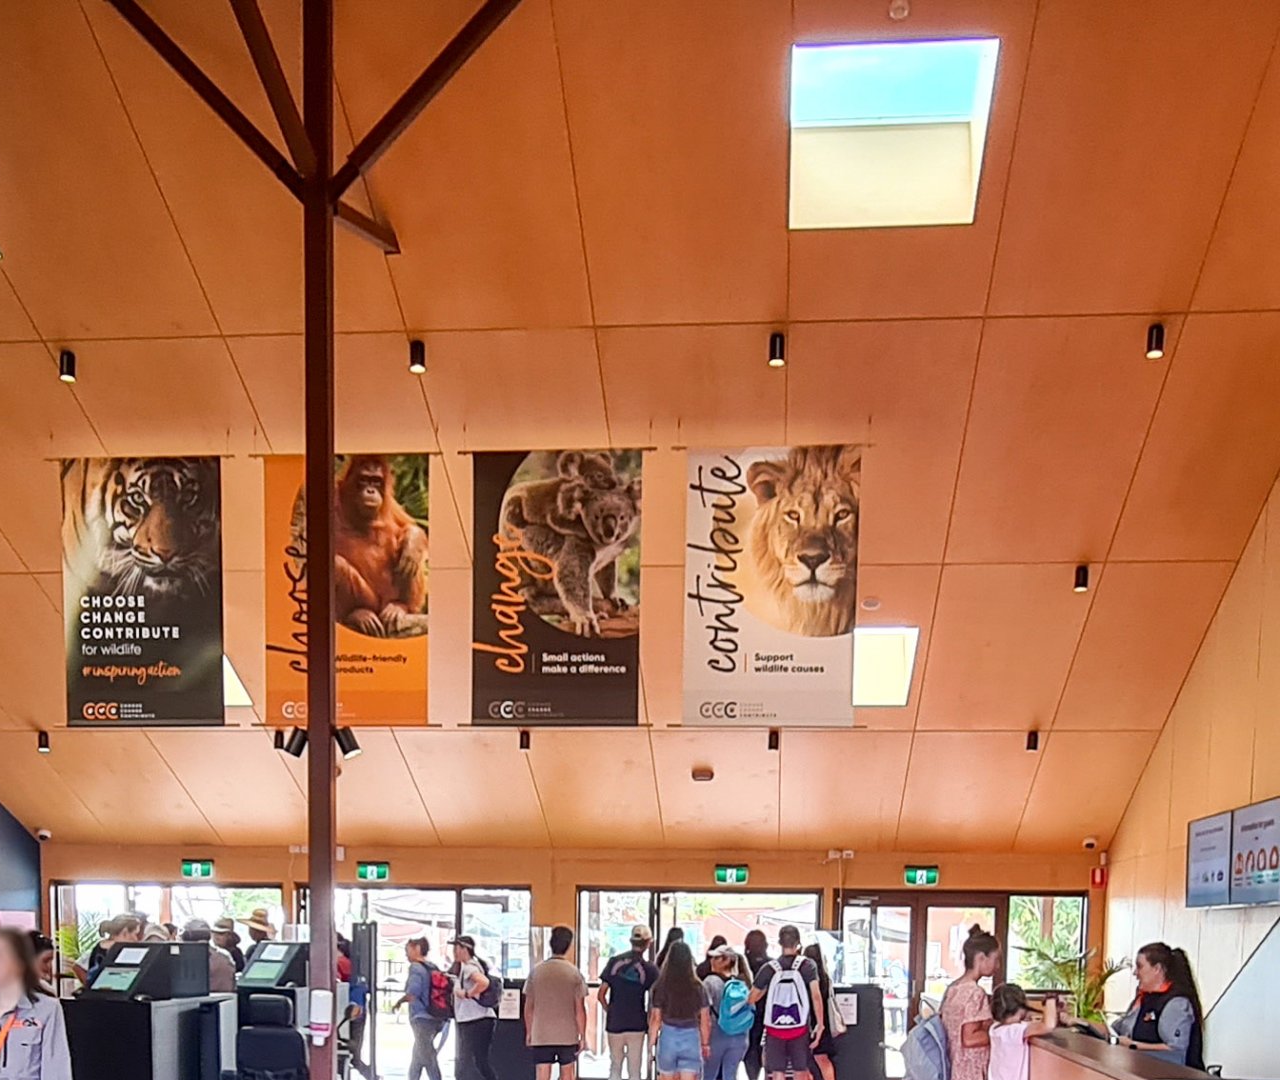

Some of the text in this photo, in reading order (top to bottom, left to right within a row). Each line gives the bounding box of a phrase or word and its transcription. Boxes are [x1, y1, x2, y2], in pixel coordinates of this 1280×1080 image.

[687, 455, 747, 673] contribute
[80, 595, 145, 608] CHOOSE
[472, 525, 557, 674] change
[80, 611, 146, 623] CHANGE
[80, 627, 180, 639] CONTRIBUTE
[81, 643, 142, 656] for wildlife
[542, 652, 605, 662] Small actions
[754, 653, 794, 662] Support
[542, 664, 568, 673] make
[579, 664, 626, 673] difference
[754, 664, 789, 673] wildlife
